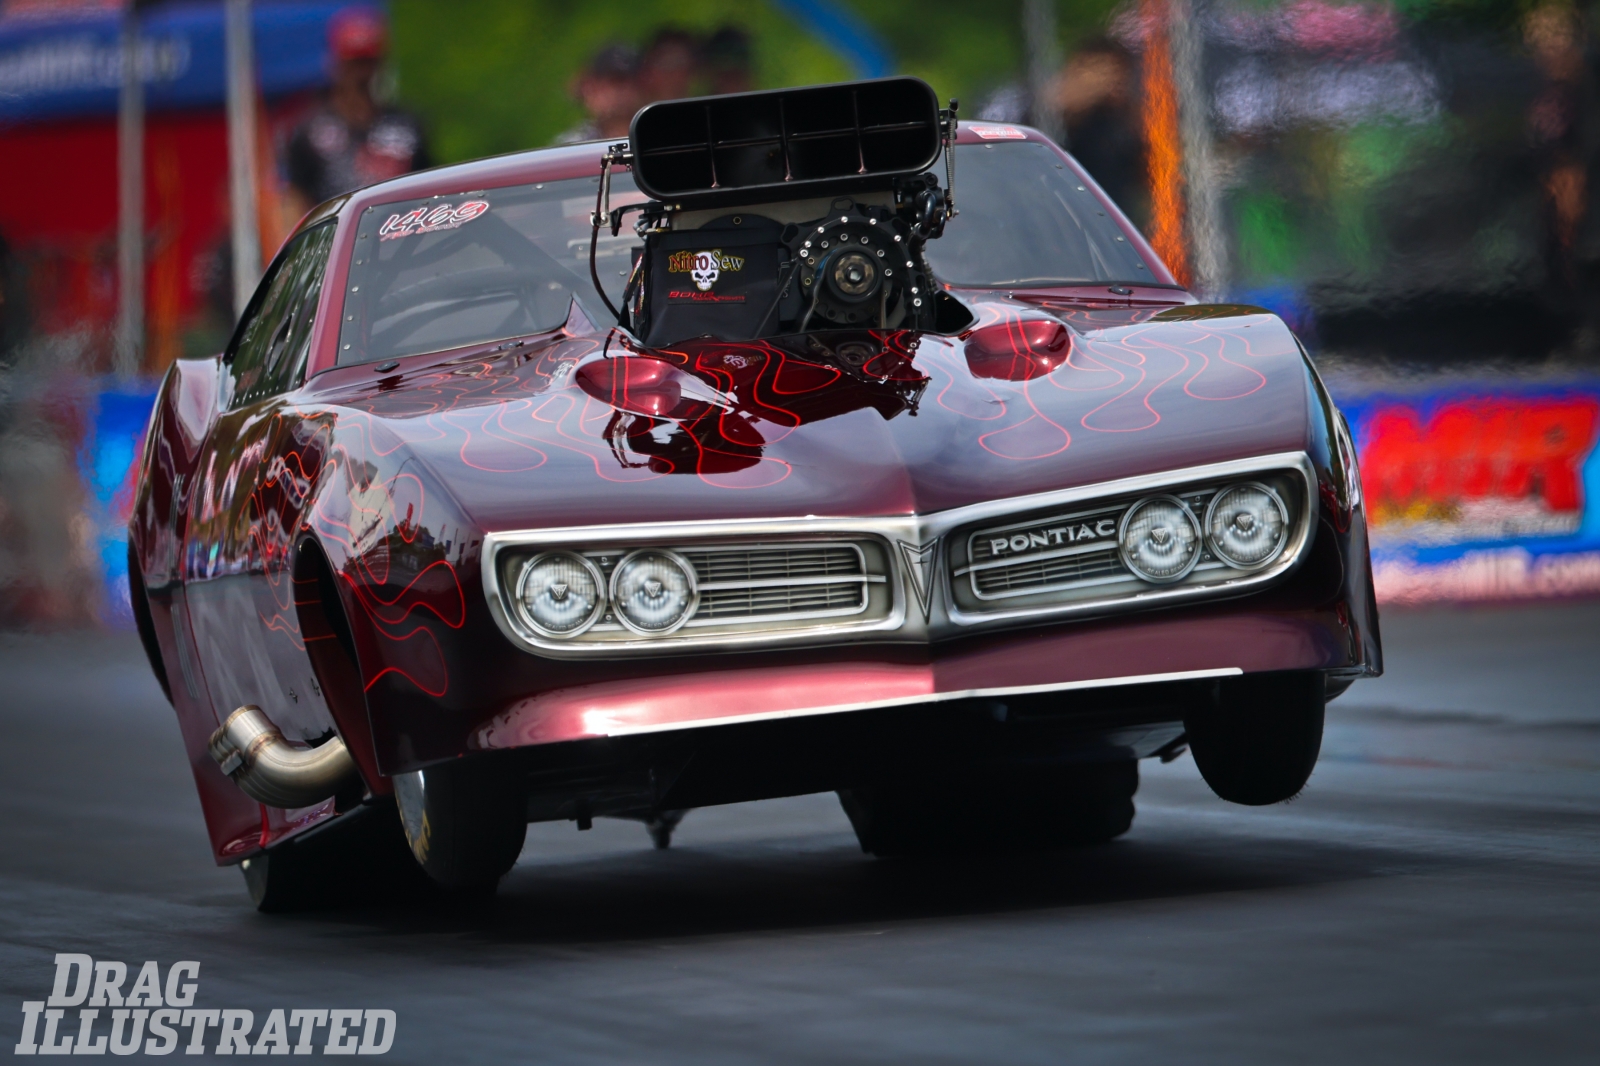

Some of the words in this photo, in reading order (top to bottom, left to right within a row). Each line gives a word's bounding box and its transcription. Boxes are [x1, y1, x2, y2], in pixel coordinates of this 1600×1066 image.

[668, 251, 709, 272] Nitro
[711, 249, 745, 271] Sew
[990, 519, 1116, 556] PONTIAC
[1146, 567, 1169, 576] SEALED
[544, 622, 567, 630] SEALED
[567, 618, 583, 629] BEAM
[639, 621, 662, 629] SEALED
